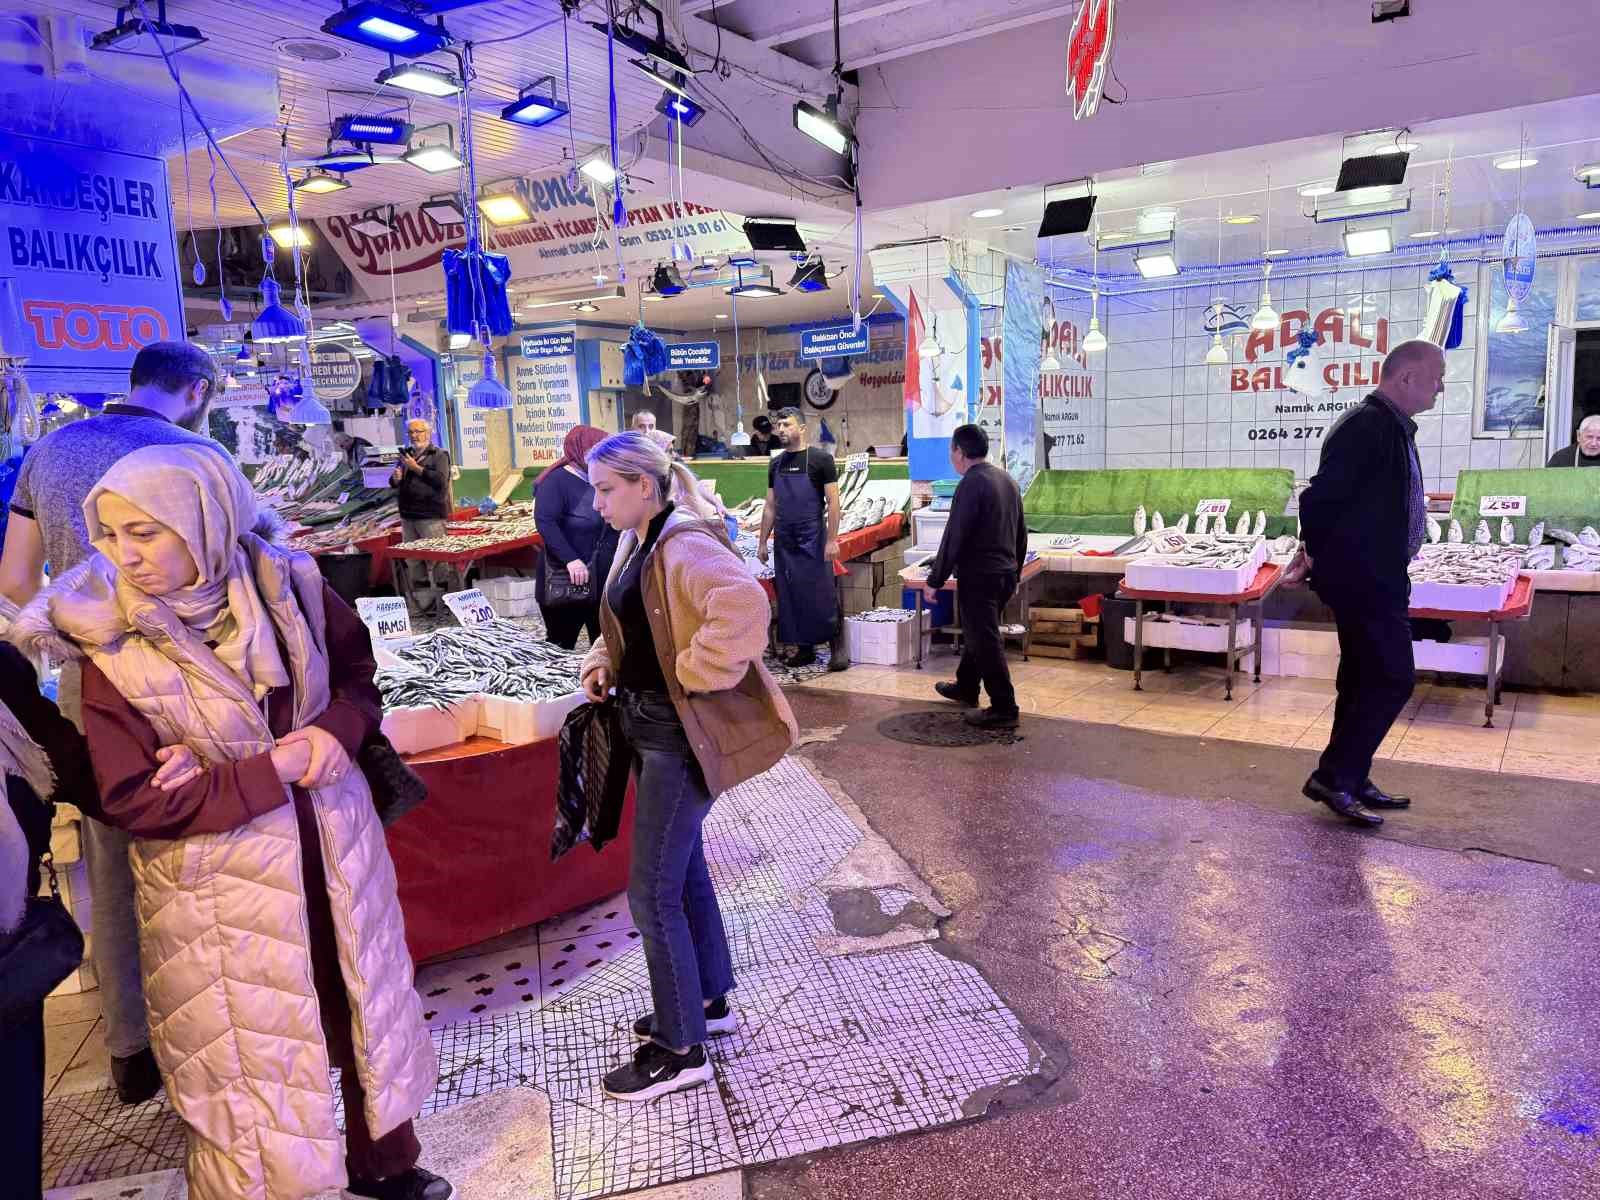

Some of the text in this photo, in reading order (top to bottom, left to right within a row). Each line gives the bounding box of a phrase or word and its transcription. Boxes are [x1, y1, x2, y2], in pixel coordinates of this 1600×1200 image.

[0, 163, 158, 222] KAEŞLER
[8, 226, 163, 284] BALIKÇILIK
[24, 300, 169, 350] TOTO
[1245, 307, 1389, 364] ADALI
[1231, 361, 1380, 393] BALÇILI
[1248, 426, 1325, 441] 0264 277
[471, 605, 494, 623] 200
